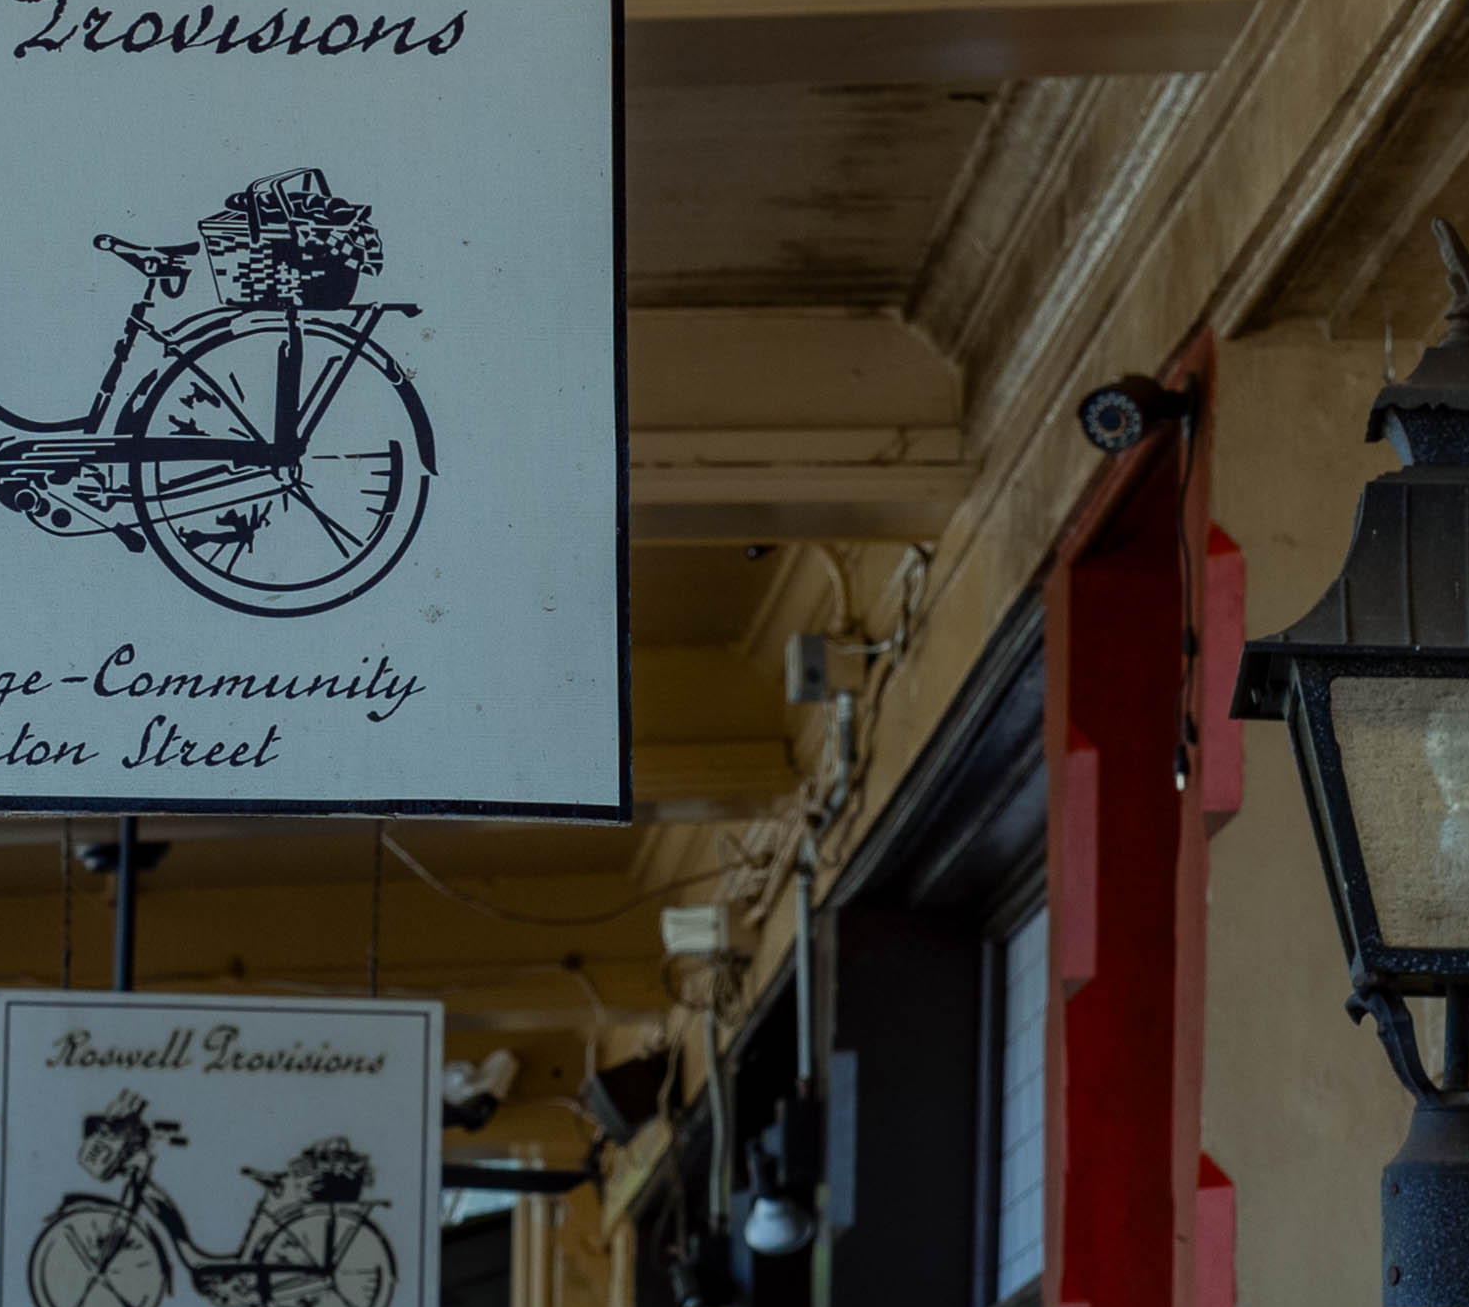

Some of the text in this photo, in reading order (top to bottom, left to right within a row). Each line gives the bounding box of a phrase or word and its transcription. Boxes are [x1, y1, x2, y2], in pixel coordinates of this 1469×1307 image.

[122, 714, 282, 769] Street
[46, 1024, 386, 1075] Roswell Provisions
